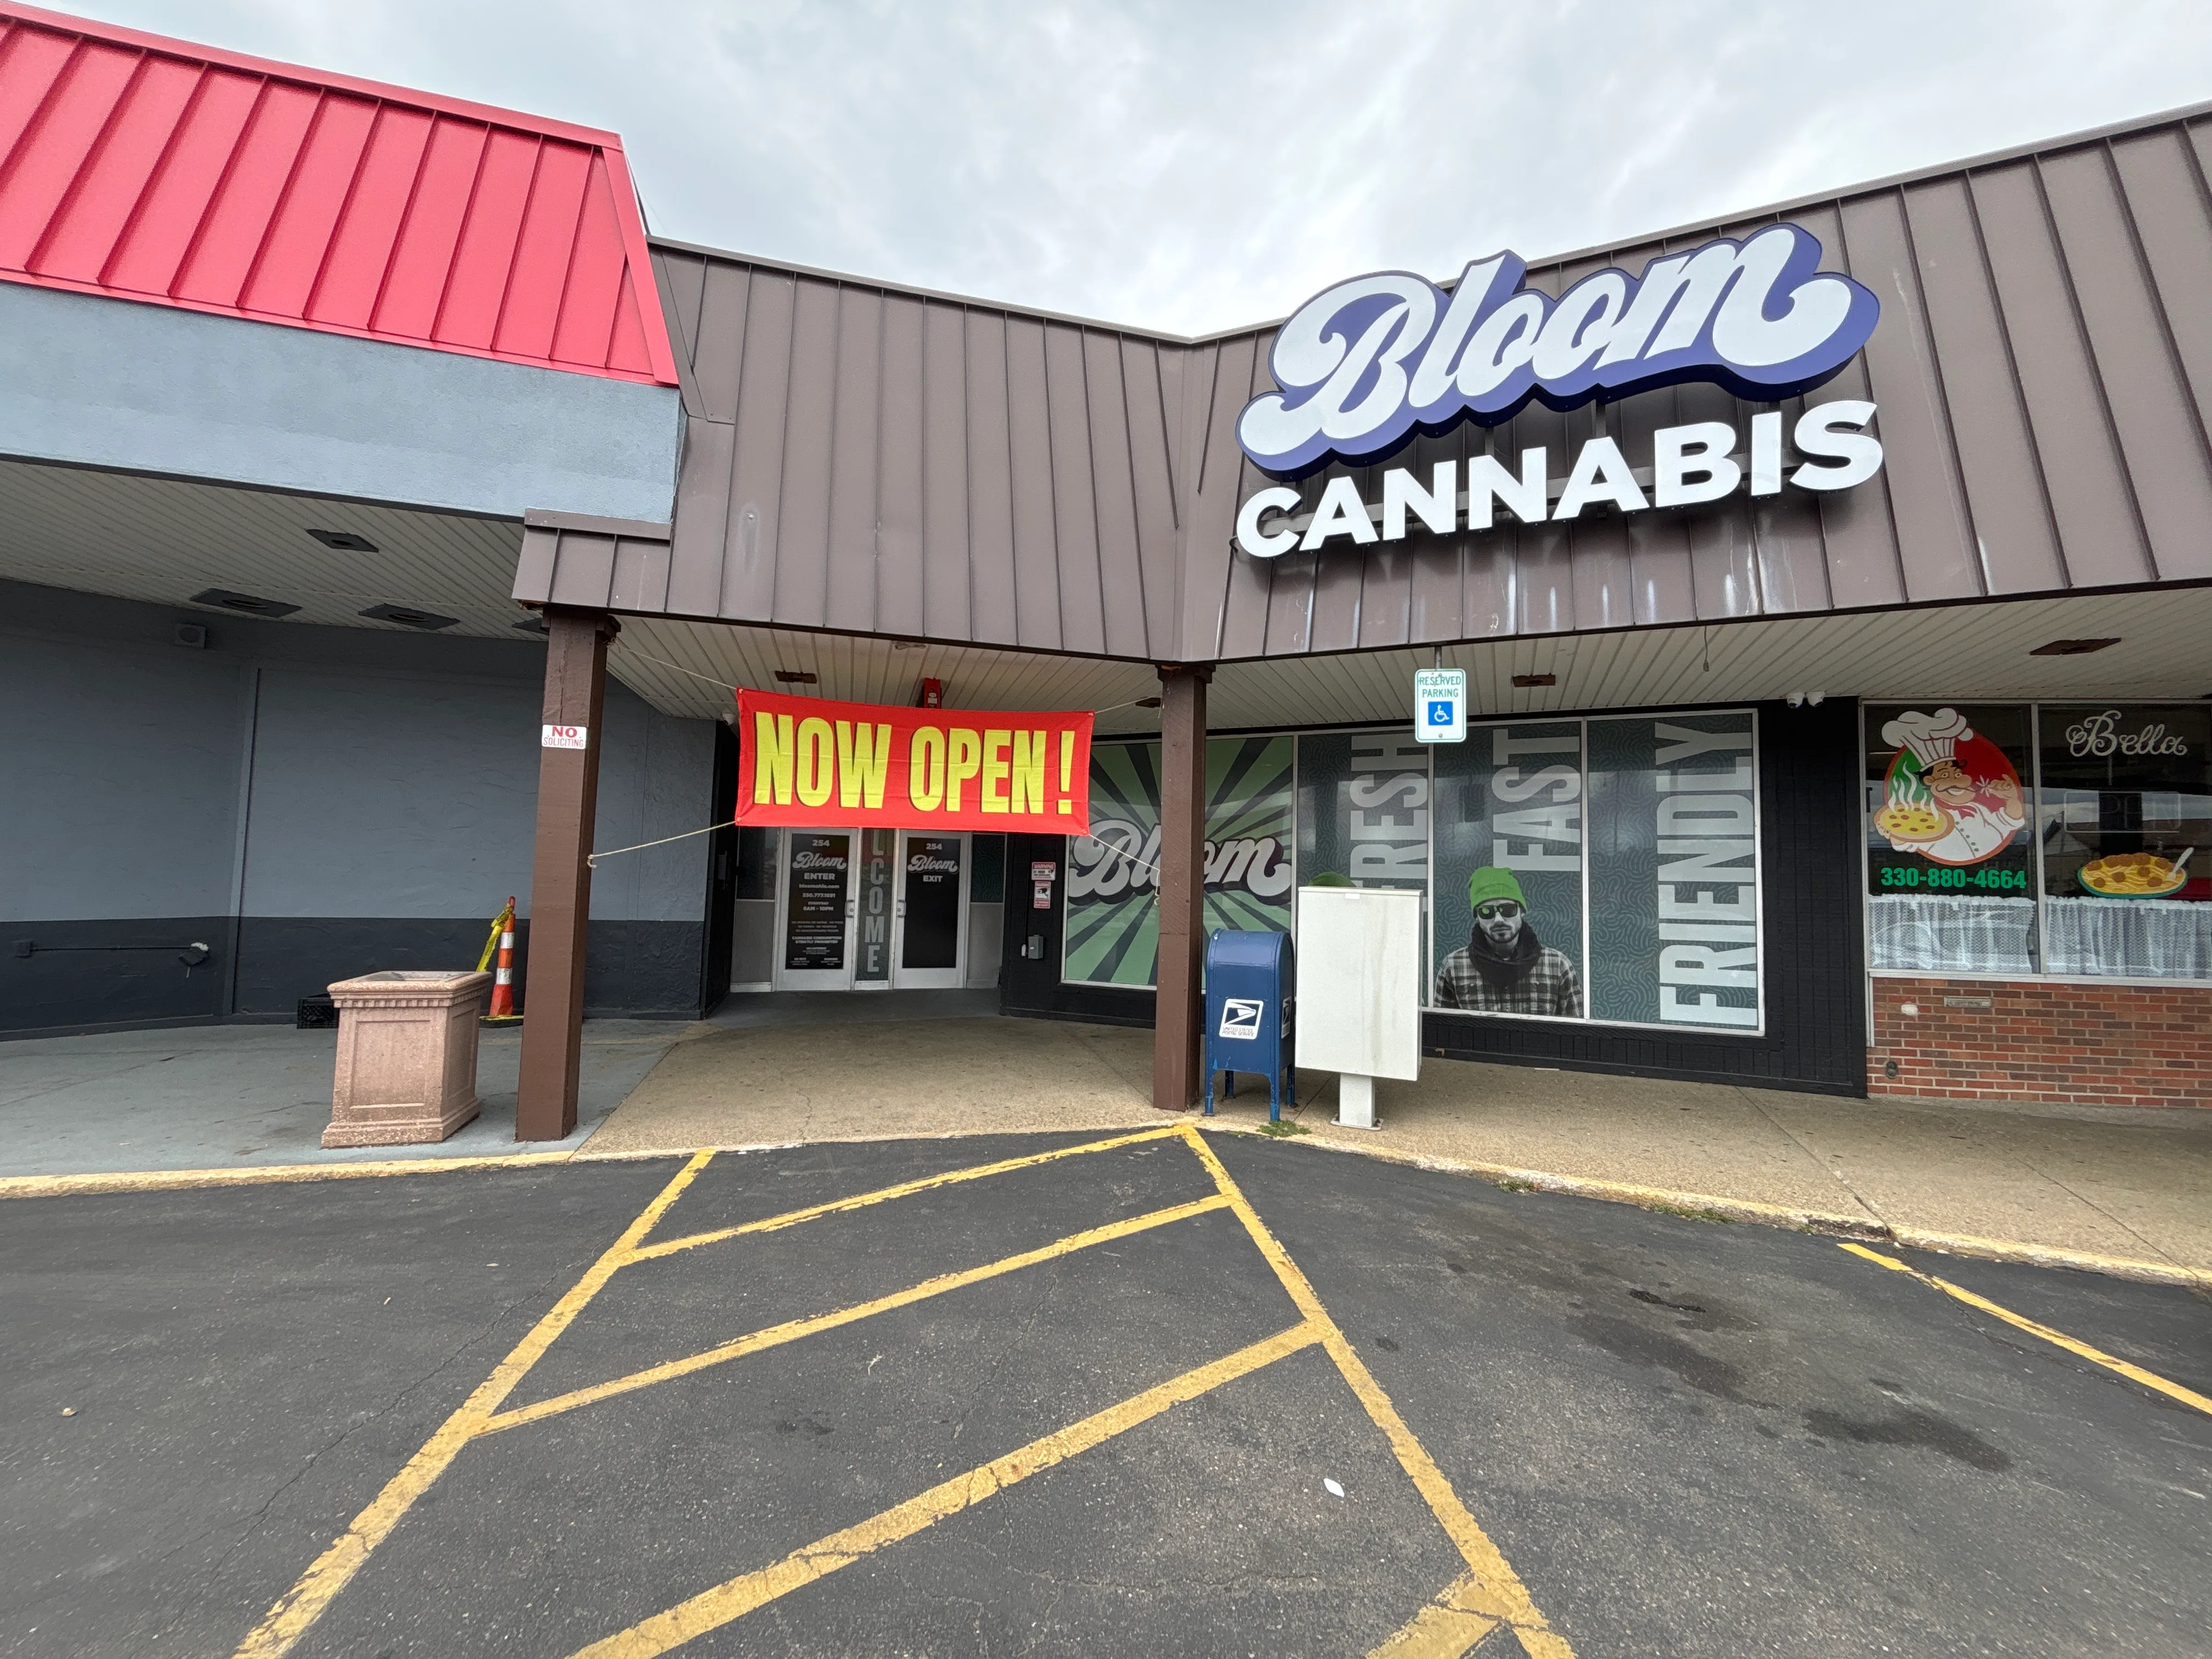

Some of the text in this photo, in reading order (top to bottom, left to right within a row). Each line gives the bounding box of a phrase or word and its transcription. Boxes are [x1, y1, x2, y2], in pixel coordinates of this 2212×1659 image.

[1237, 223, 1874, 476] Bloom
[1237, 400, 1883, 558] CANNABIS
[1419, 676, 1462, 686] RESERVED
[1422, 689, 1459, 698] PARKING
[544, 737, 583, 747] SOLICITING
[552, 726, 577, 738] NO
[2065, 710, 2188, 757] Bella
[754, 711, 892, 809] NOW
[1350, 733, 1428, 888] RESH
[1491, 728, 1581, 872] FAST
[812, 839, 831, 847] 254
[1068, 820, 1291, 900] Blm
[792, 851, 847, 871] Bloom
[907, 854, 958, 873] Bloom
[1654, 721, 1758, 1026] FRIENDLY
[1880, 867, 2027, 889] 330-880-4664
